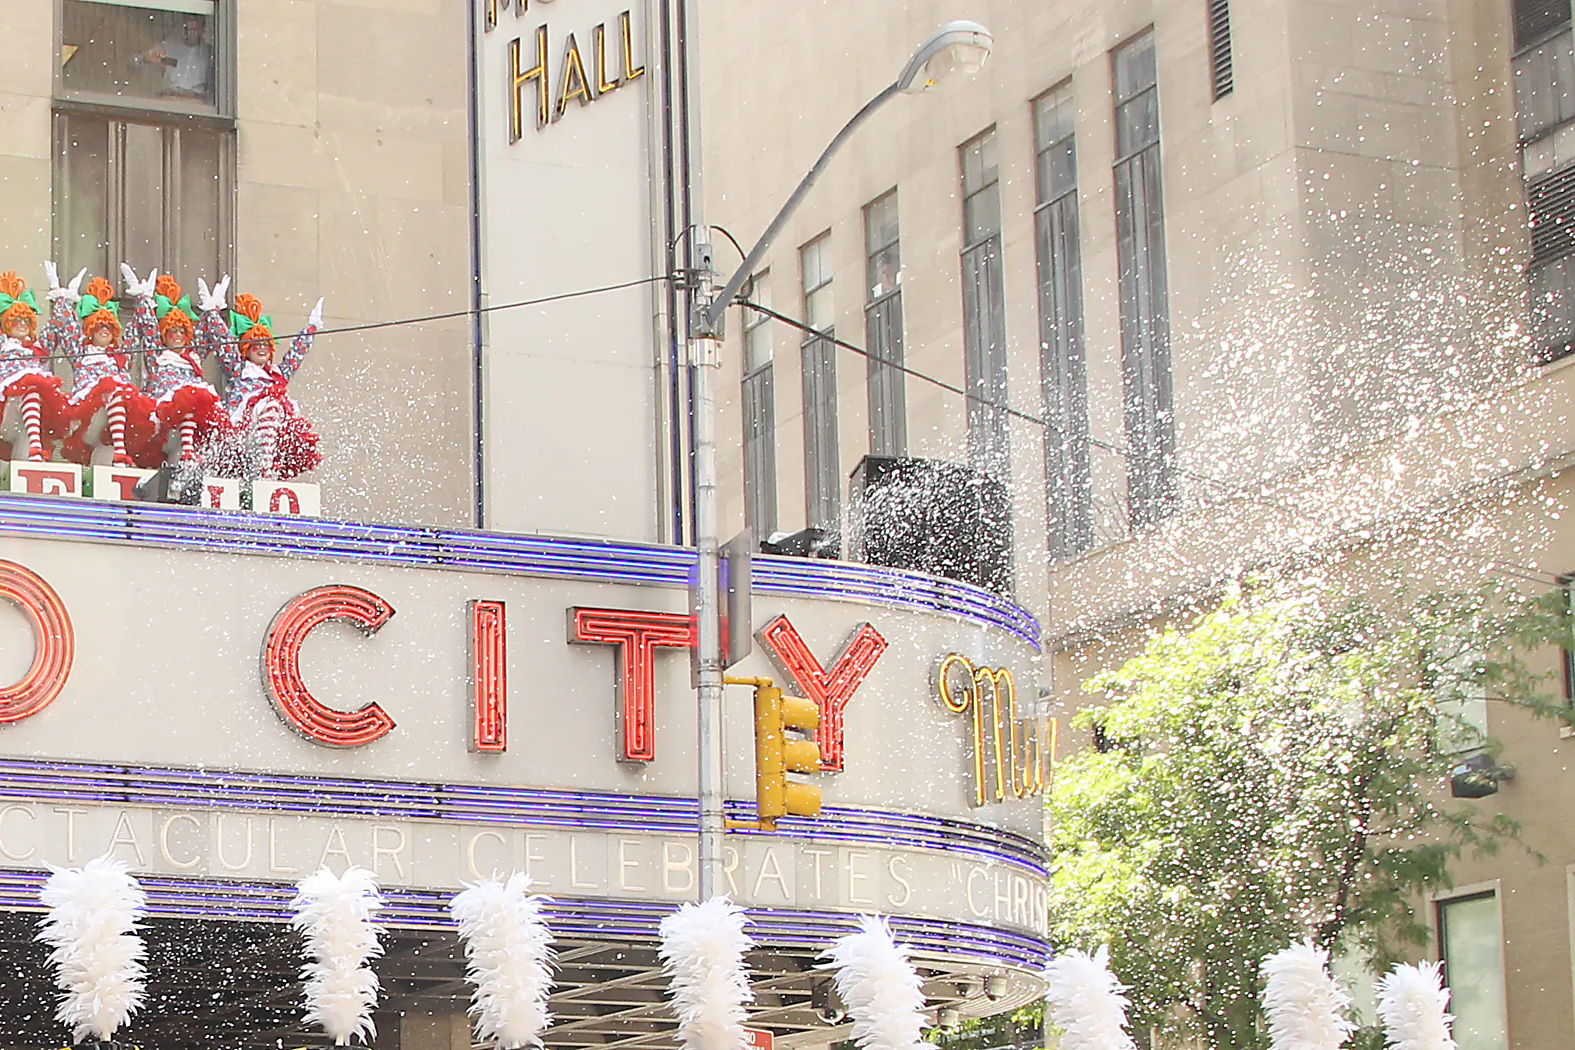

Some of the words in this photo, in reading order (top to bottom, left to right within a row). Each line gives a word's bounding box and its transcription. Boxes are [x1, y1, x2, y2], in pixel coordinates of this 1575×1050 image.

[507, 9, 645, 145] HALL
[260, 583, 889, 774] CITY
[466, 831, 912, 908] CELEBRATES
[951, 863, 1049, 939] "CHRIS
